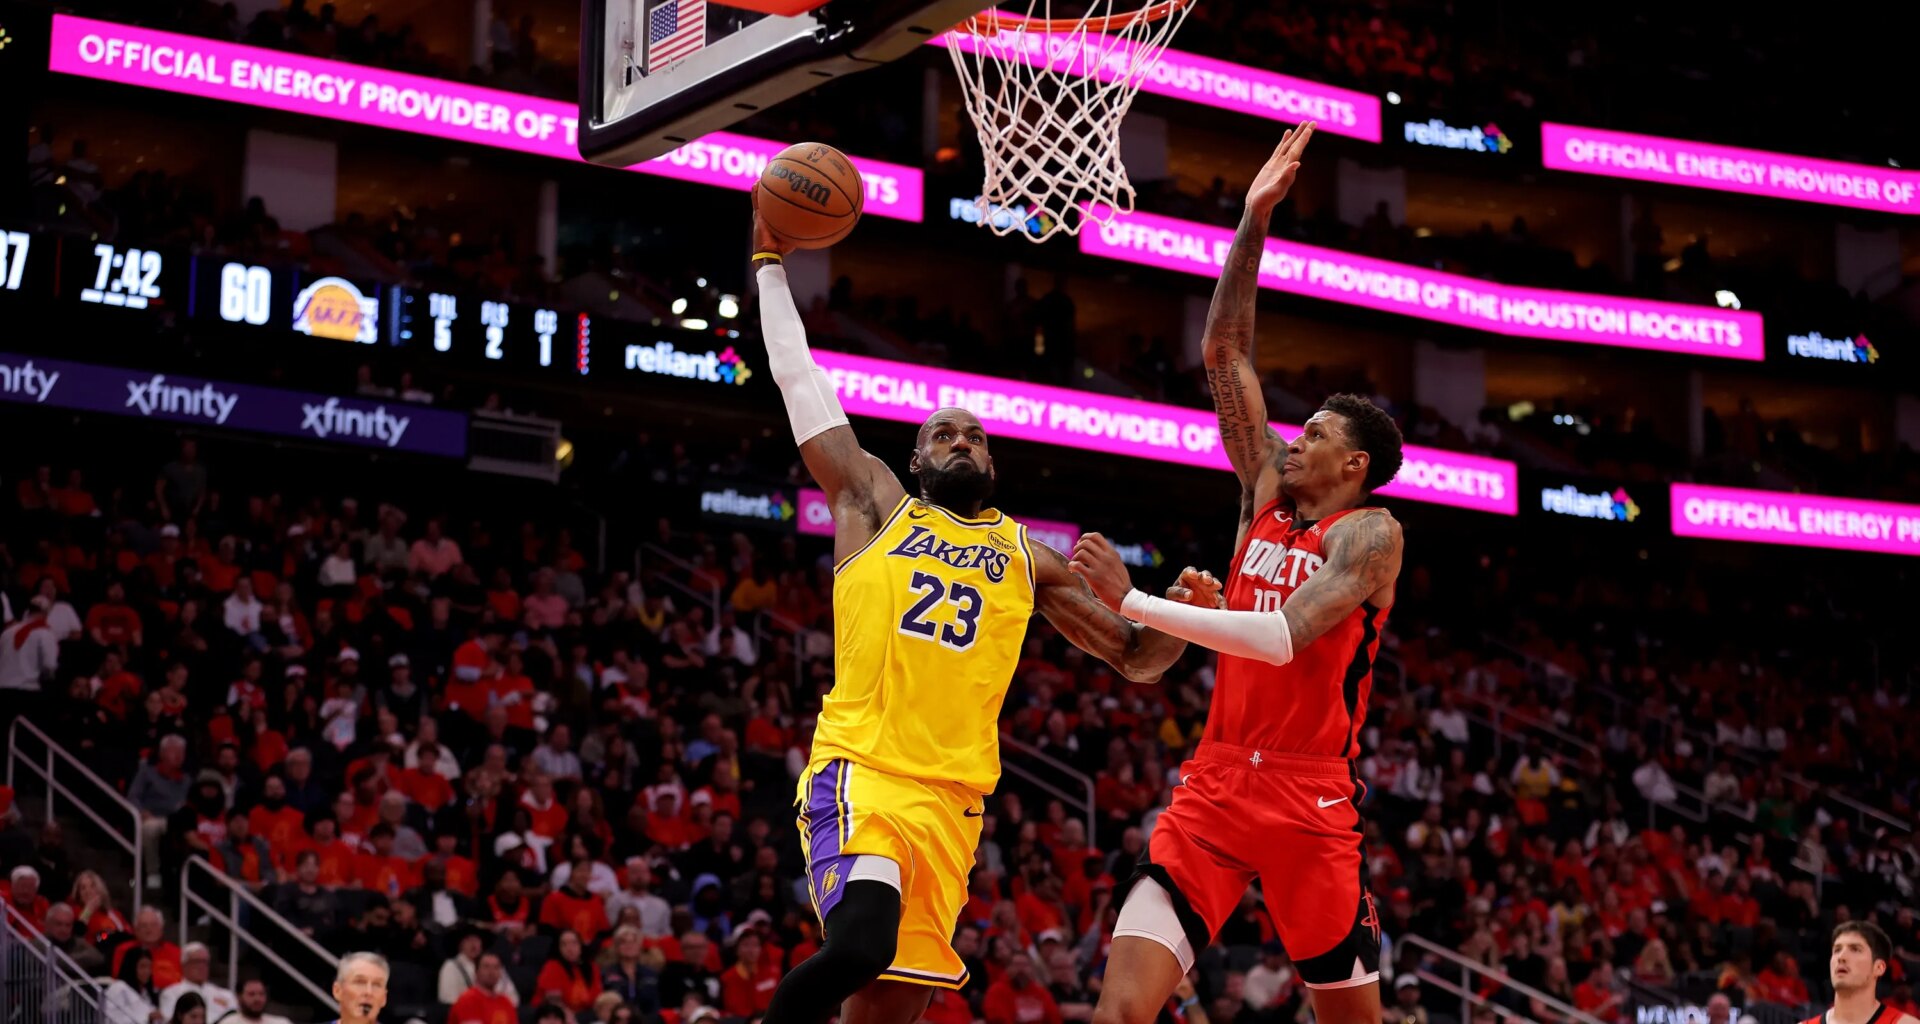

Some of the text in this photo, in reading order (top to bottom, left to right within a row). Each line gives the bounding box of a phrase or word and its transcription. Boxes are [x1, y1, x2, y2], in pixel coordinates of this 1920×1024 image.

[78, 34, 225, 84] OFFICIAL
[230, 59, 355, 105] ENERGY
[360, 81, 510, 133] PROVIDER
[514, 110, 556, 140] OF
[1252, 82, 1357, 127] ROCKETS
[1404, 118, 1486, 152] reliant
[653, 141, 768, 178] USTON
[1565, 138, 1914, 204] OFFICIAL ENERGY PROVIDER OF
[770, 163, 831, 207] Wilson
[94, 243, 162, 298] 7:42
[220, 261, 271, 325] 60
[1100, 220, 1743, 347] OFFICIAL ERGY PROVIDER OF THE HOUSTON ROCKETS
[434, 318, 551, 366] 5 2 1
[625, 341, 721, 382] reliant
[1787, 331, 1857, 362] reliant
[0, 360, 60, 402] nity
[126, 374, 238, 424] xfinity
[1215, 344, 1238, 419] MEDIOCRITY
[301, 397, 409, 446] xfinity
[818, 365, 1218, 453] FFICIAL ENERGY PROVIDER OF
[1244, 425, 1260, 462] Breeds
[1396, 458, 1505, 500] ROCKETS
[701, 488, 771, 519] reliant
[1542, 485, 1615, 520] reliant
[1684, 497, 1798, 533] OFFICIAL
[1799, 506, 1893, 541] ENERGY
[888, 525, 1011, 584] LAKERS
[990, 533, 1015, 551] bibigo
[897, 570, 984, 653] 23
